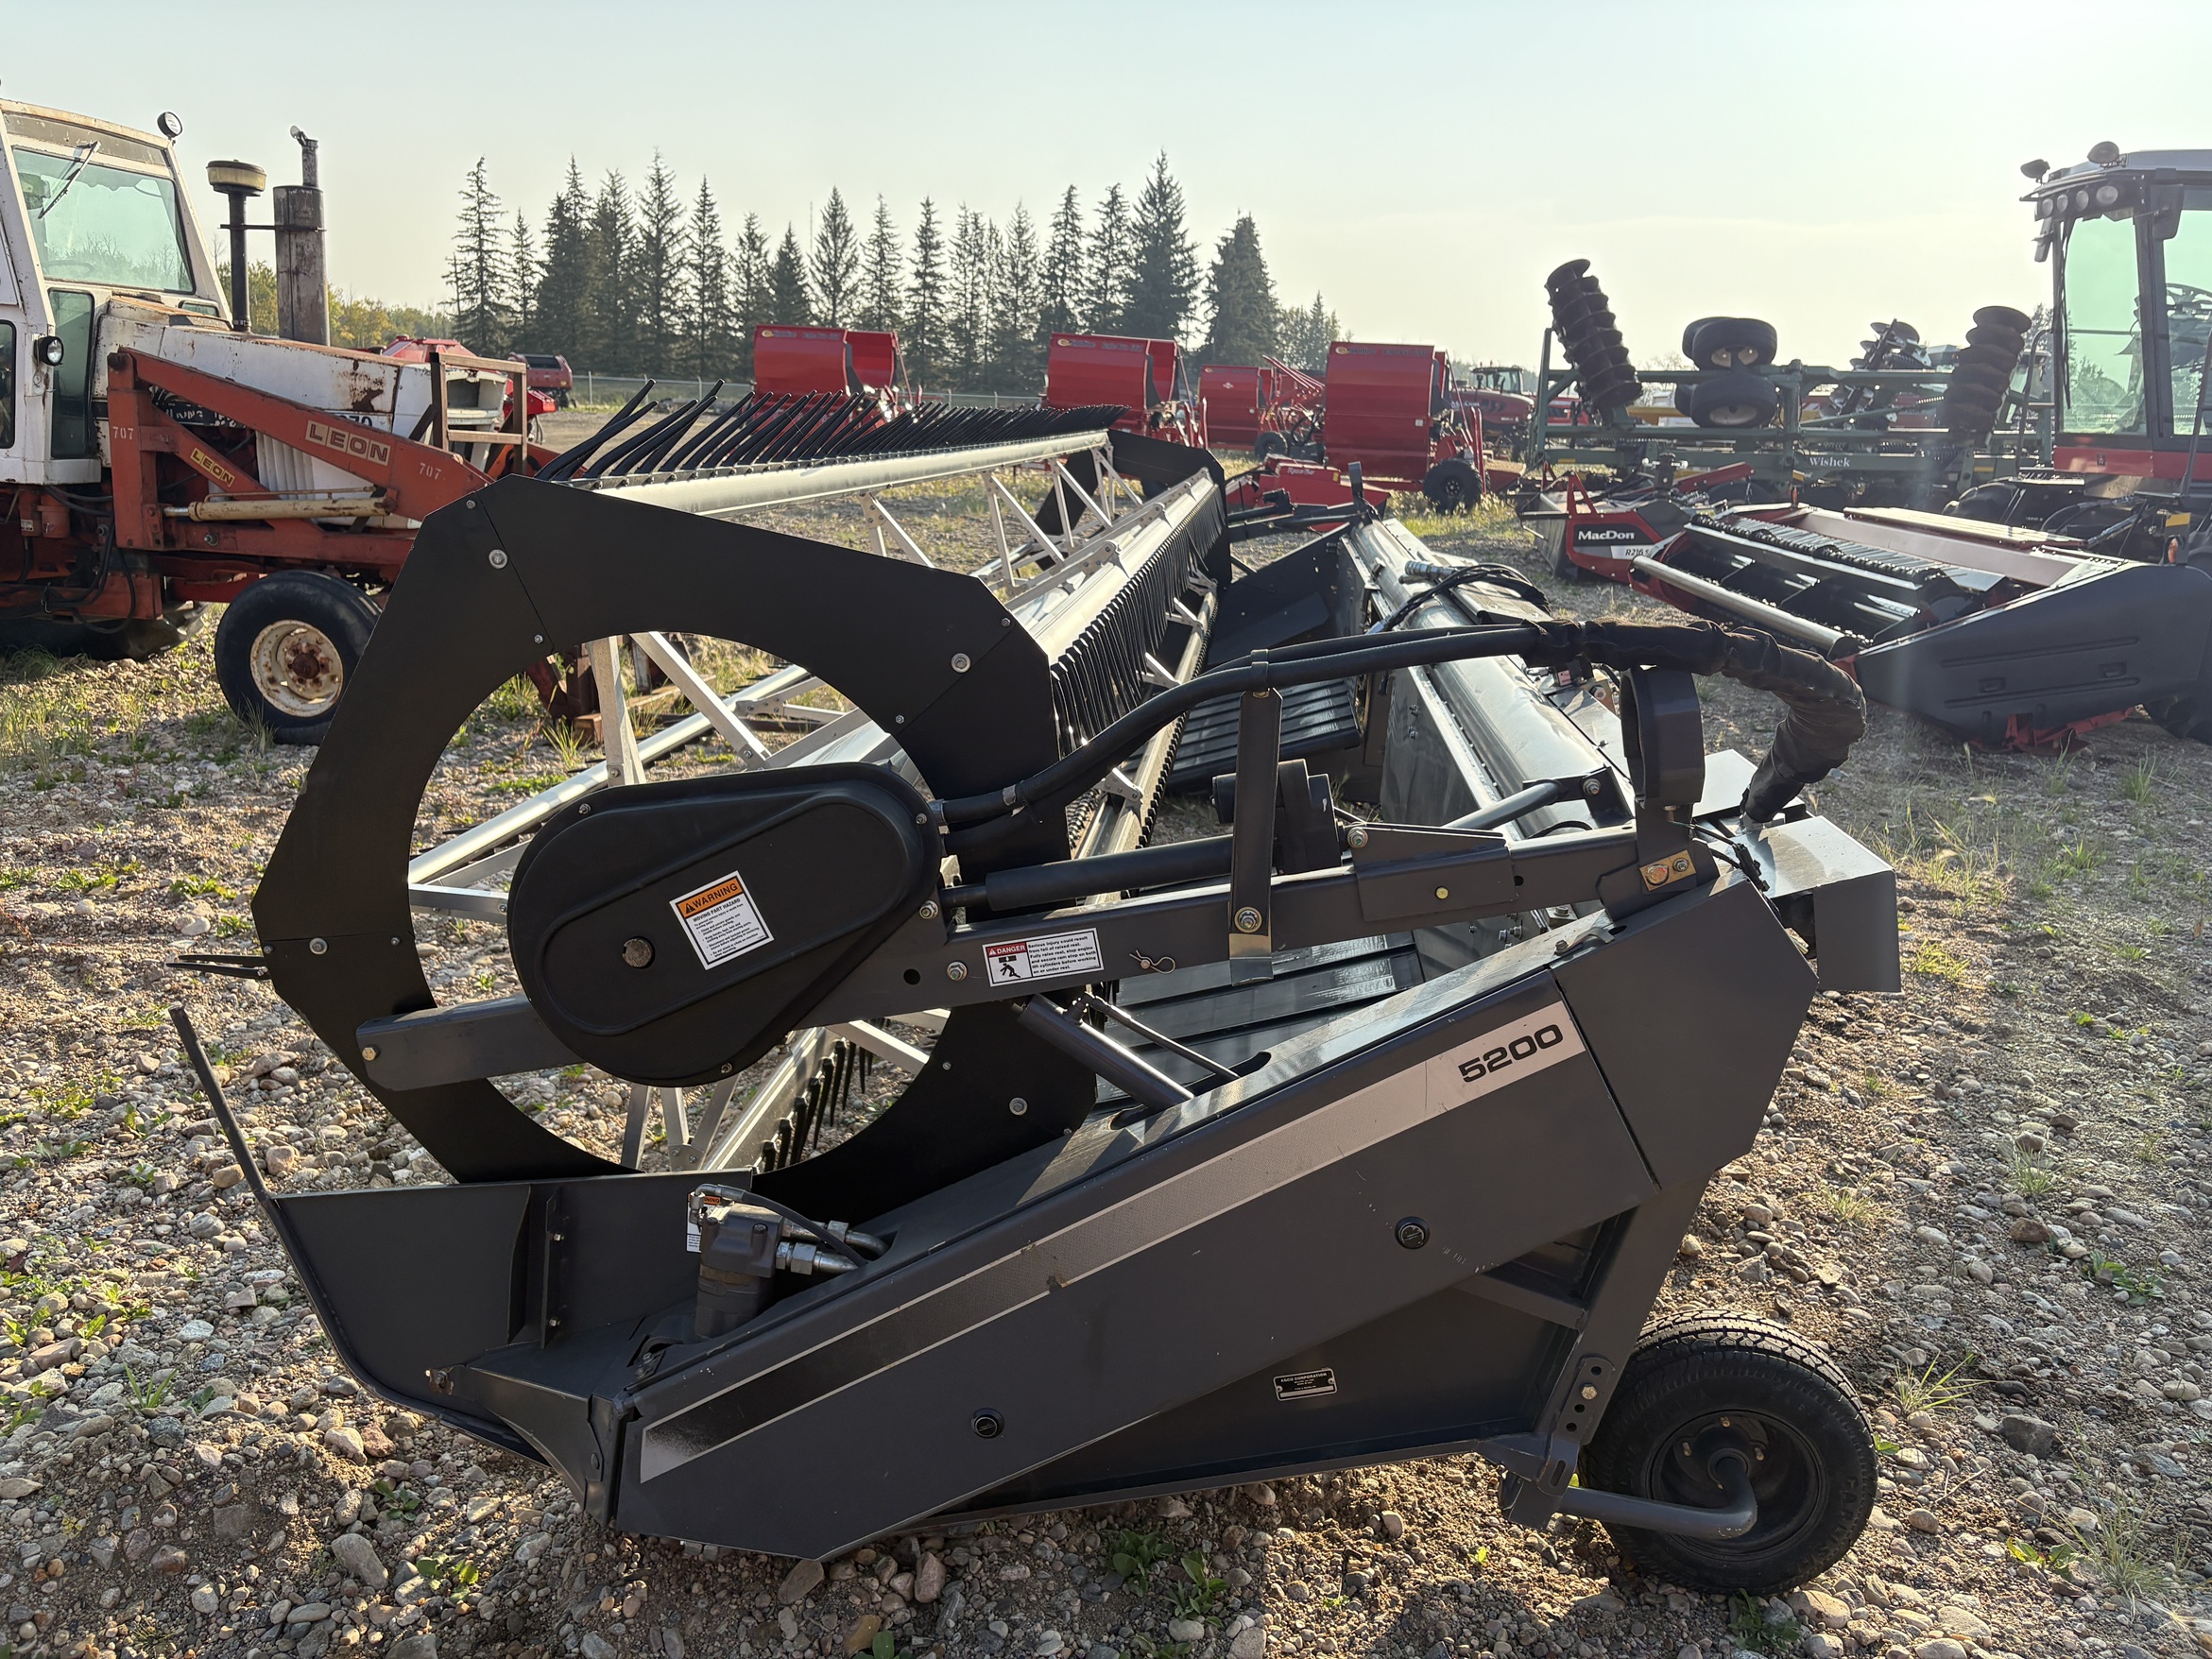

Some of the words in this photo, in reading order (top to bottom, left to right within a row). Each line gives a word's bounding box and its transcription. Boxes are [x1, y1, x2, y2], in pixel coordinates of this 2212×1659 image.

[112, 426, 134, 440] 707
[309, 424, 388, 461] LEON
[193, 450, 233, 485] LEON
[1809, 456, 1850, 467] Wishek
[419, 463, 442, 480] 707
[1578, 530, 1635, 540] MacDon
[1625, 548, 1644, 556] R216
[693, 883, 738, 908] WARNING
[711, 906, 723, 915] PART
[997, 945, 1026, 954] DANGER
[1458, 1024, 1564, 1083] 5200
